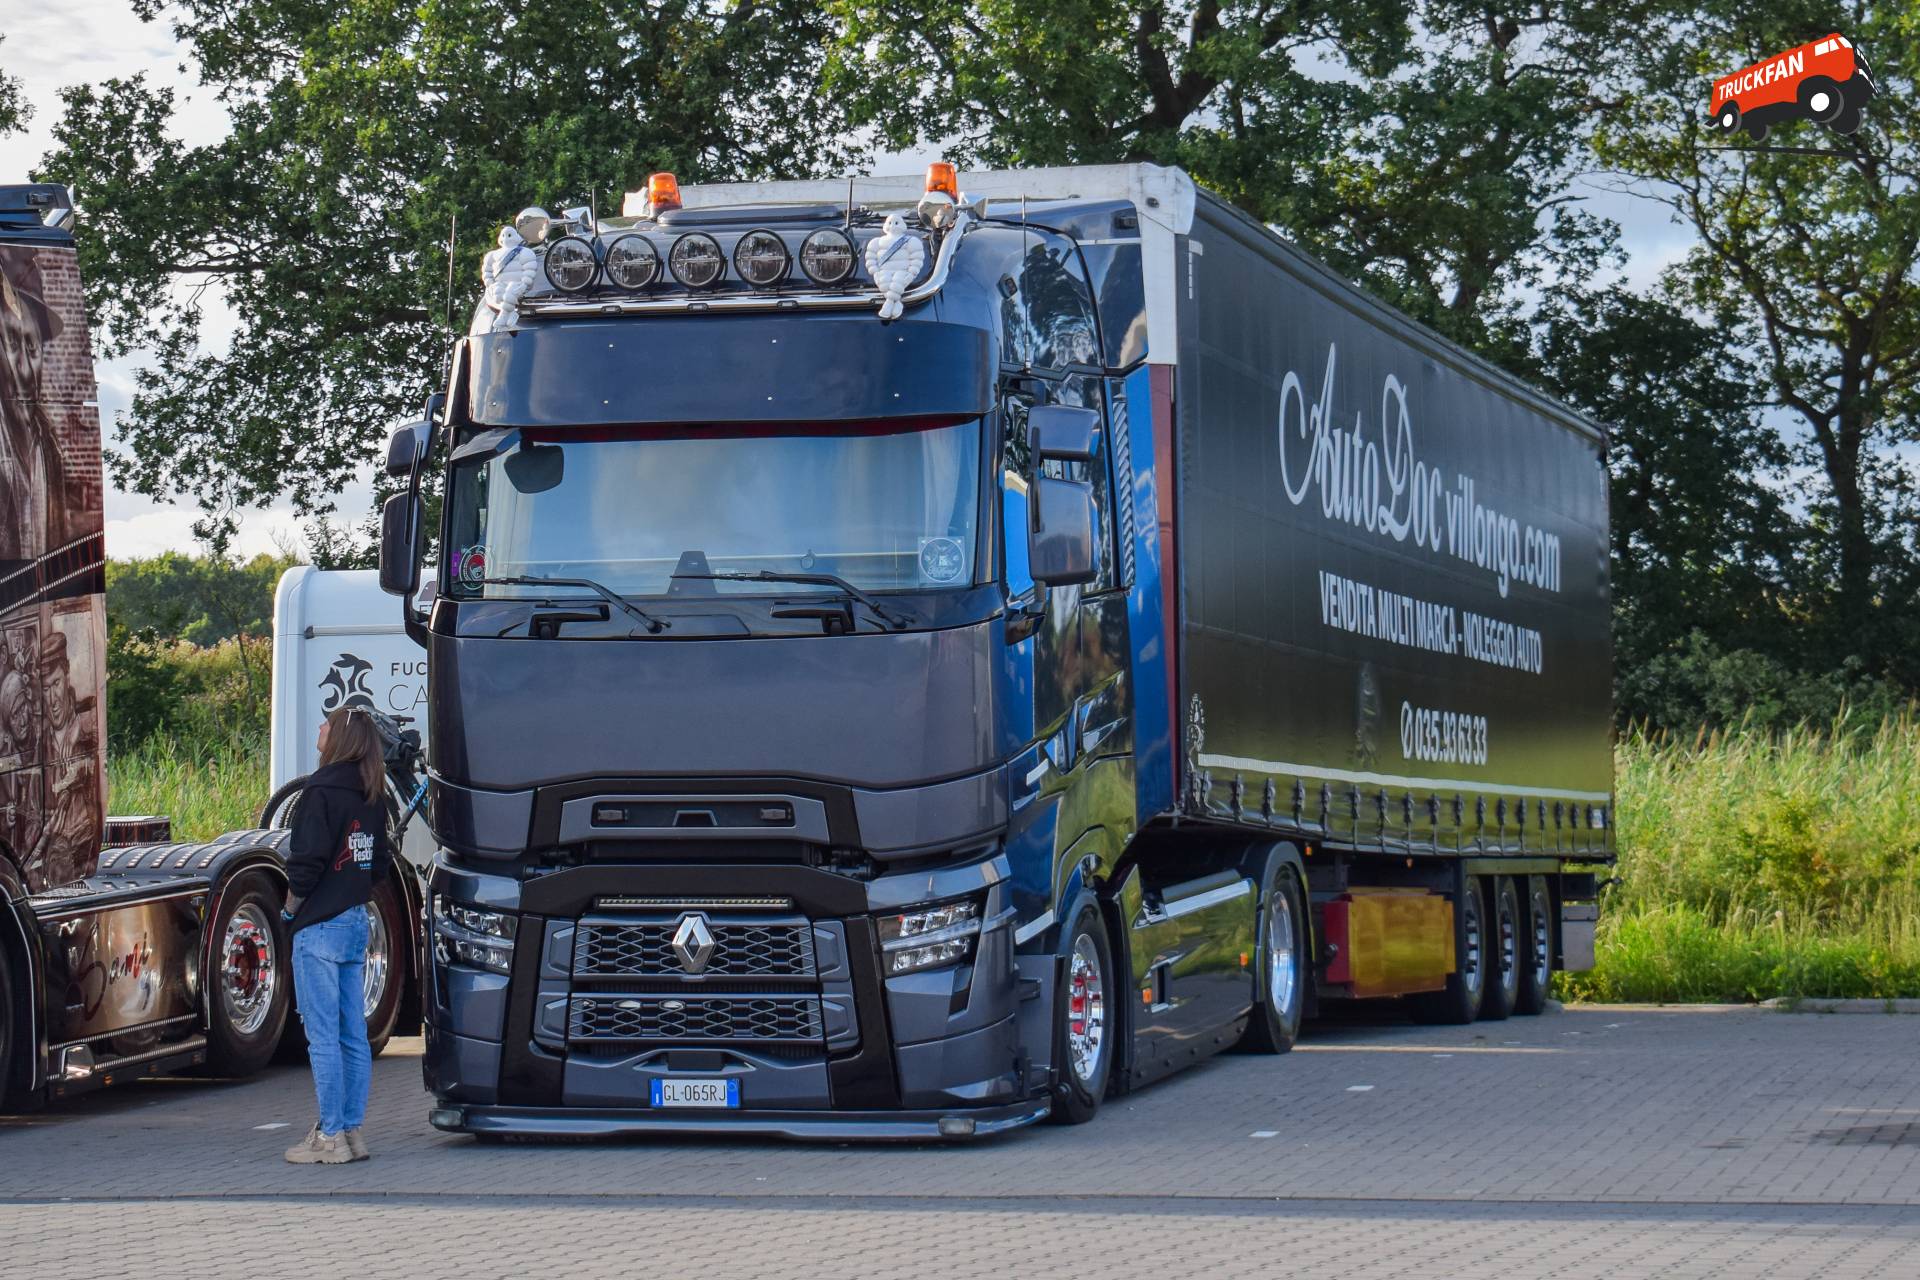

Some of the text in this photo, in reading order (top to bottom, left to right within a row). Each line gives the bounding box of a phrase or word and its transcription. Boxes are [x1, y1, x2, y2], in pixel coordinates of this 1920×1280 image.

[1446, 473, 1561, 598] villongo.com
[1319, 570, 1376, 638] VENDITA
[1378, 589, 1414, 647] MULTI
[1415, 600, 1457, 655] MARCA
[1463, 611, 1516, 668] NOLEGGIO
[1516, 626, 1543, 675] AUTO
